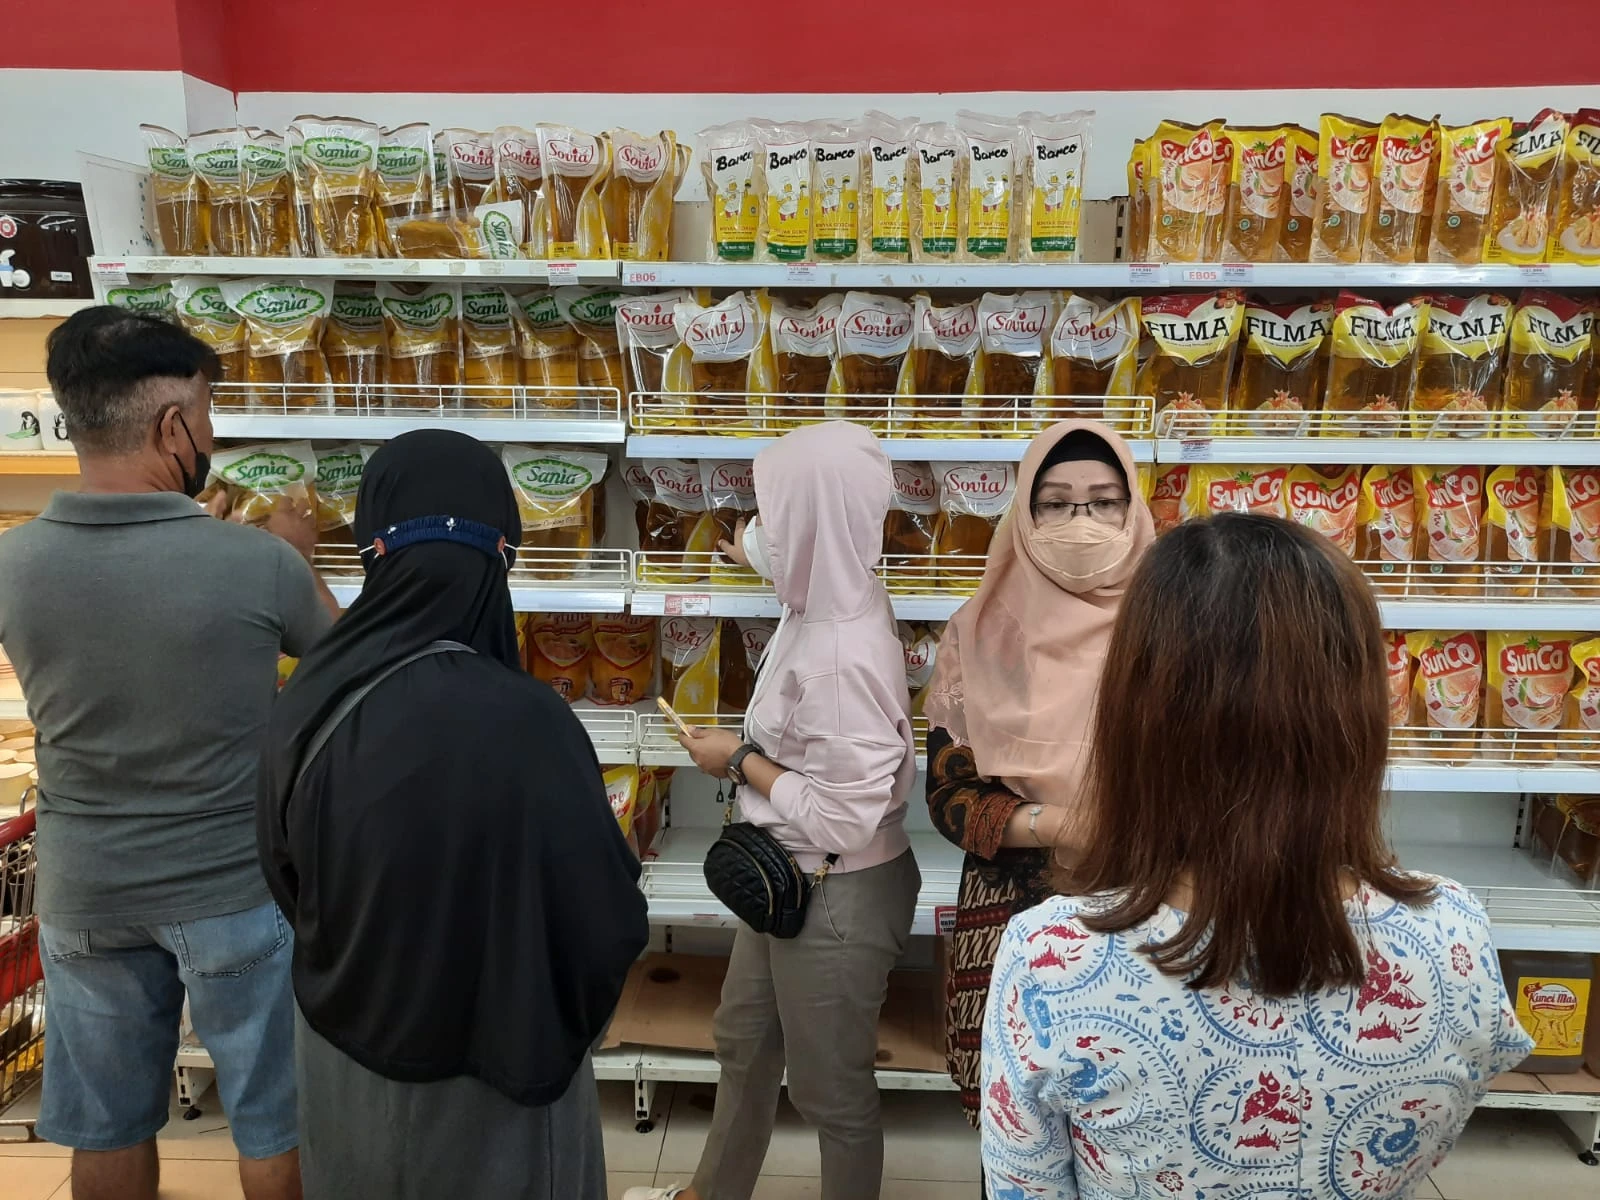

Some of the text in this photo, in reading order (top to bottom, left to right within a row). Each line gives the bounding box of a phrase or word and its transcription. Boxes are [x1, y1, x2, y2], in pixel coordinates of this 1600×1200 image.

[158, 153, 189, 168] Sani
[205, 155, 239, 168] Sani
[315, 143, 360, 160] Sania
[377, 152, 417, 168] Sania
[453, 145, 493, 166] Sovia
[502, 143, 540, 166] Sovia
[549, 142, 589, 163] Sovia
[621, 148, 657, 171] Sovia
[769, 149, 807, 170] Barco
[815, 148, 856, 162] Barco
[920, 149, 955, 164] Barco
[971, 145, 1009, 161] Barco
[1036, 144, 1077, 160] Barco
[630, 272, 656, 282] EB06
[1189, 271, 1217, 280] EB05
[124, 293, 173, 311] Sani
[200, 295, 235, 314] San
[254, 295, 308, 316] Sania
[334, 300, 382, 318] Sania
[396, 301, 441, 319] Sania
[466, 300, 508, 316] Sania
[528, 300, 561, 322] Sani
[584, 303, 617, 319] San
[620, 304, 675, 326] Sovia
[992, 311, 1038, 333] Sovia
[692, 312, 742, 343] Sovia
[789, 316, 835, 339] Sovia
[852, 315, 906, 338] Sovia
[933, 318, 970, 338] ovia
[1067, 316, 1112, 340] Soia
[1145, 317, 1229, 341] FILMA
[1246, 316, 1326, 342] FILMA
[1348, 316, 1417, 341] FILMA
[235, 461, 288, 481] Sania
[315, 461, 363, 482] Sania
[526, 466, 577, 486] Sania
[657, 469, 703, 493] Sovia
[718, 468, 753, 487] Sovi
[893, 473, 931, 496] Sovia
[949, 473, 1000, 492] Sovia
[1211, 476, 1284, 507] SunCo
[1294, 481, 1358, 511] SunCo
[1421, 642, 1475, 675] SunCo
[1506, 645, 1563, 673] SunCo
[1529, 993, 1556, 1003] Kunci
